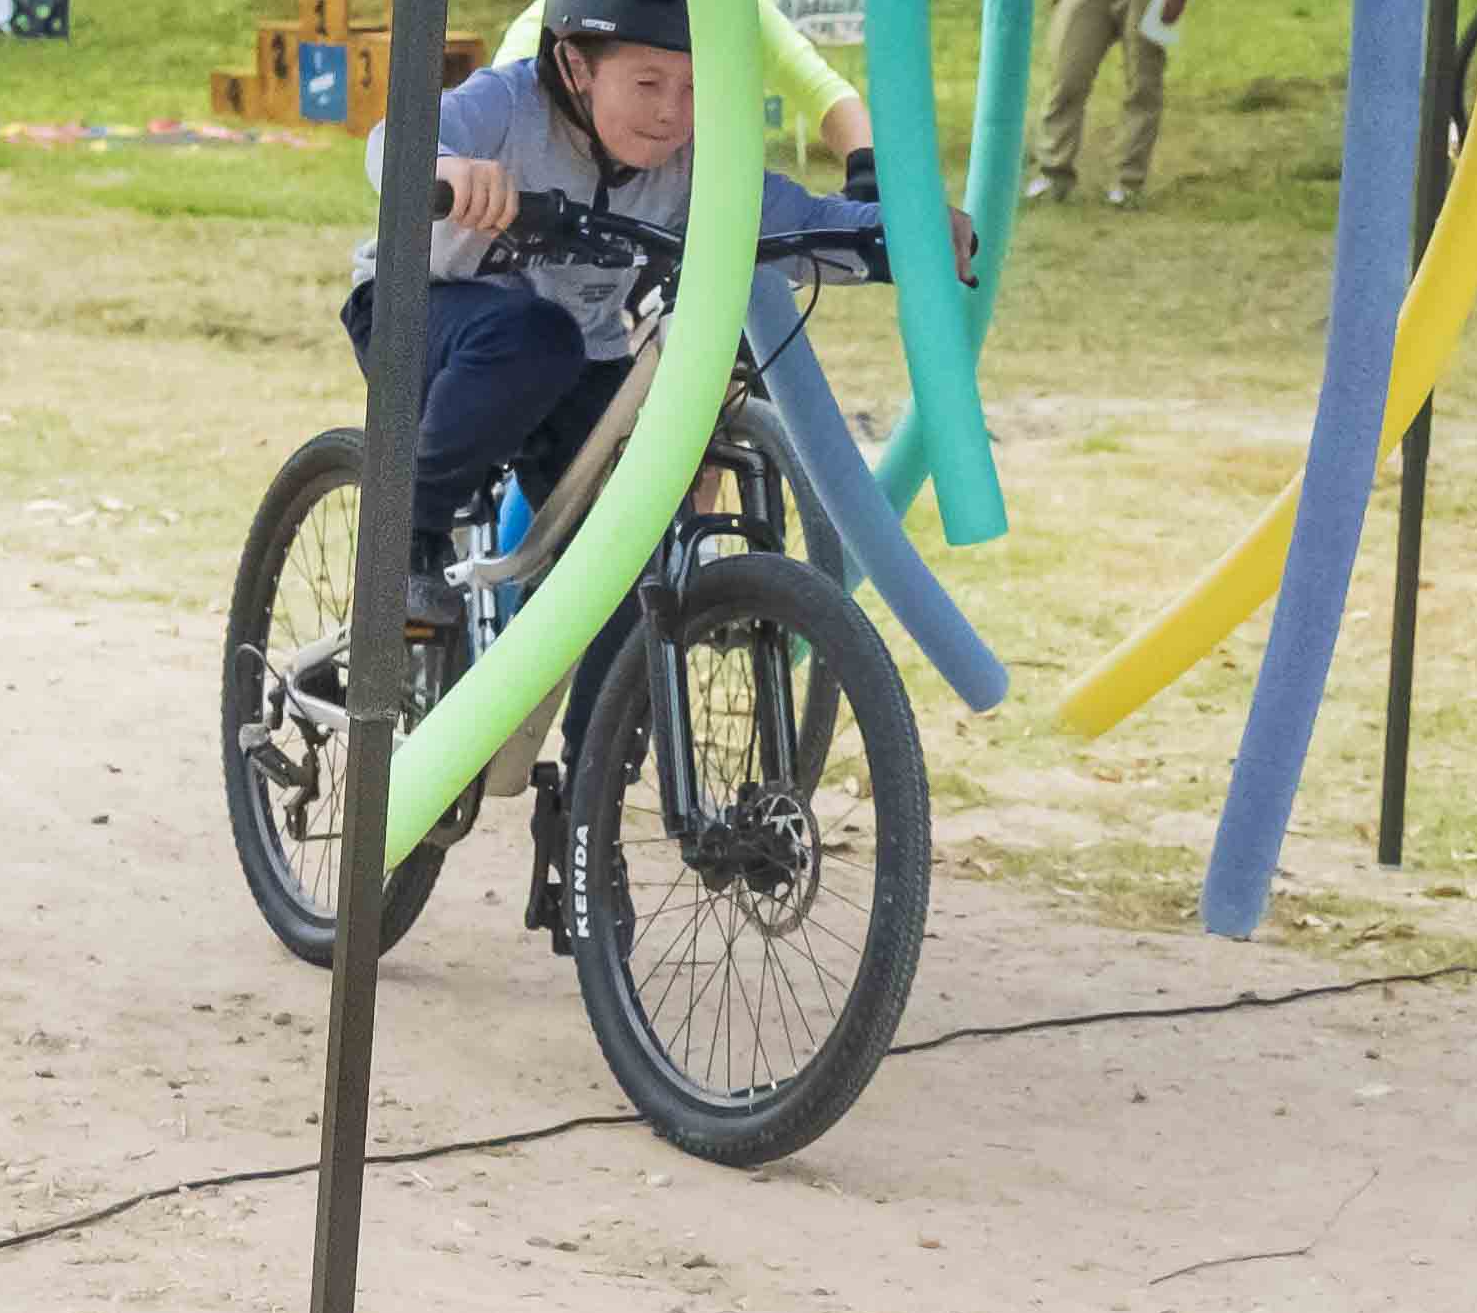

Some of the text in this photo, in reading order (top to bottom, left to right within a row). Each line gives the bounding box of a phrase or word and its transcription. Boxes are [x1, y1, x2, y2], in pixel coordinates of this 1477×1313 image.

[271, 30, 288, 80] 2
[358, 47, 373, 90] 3
[573, 824, 590, 939] KENDA
